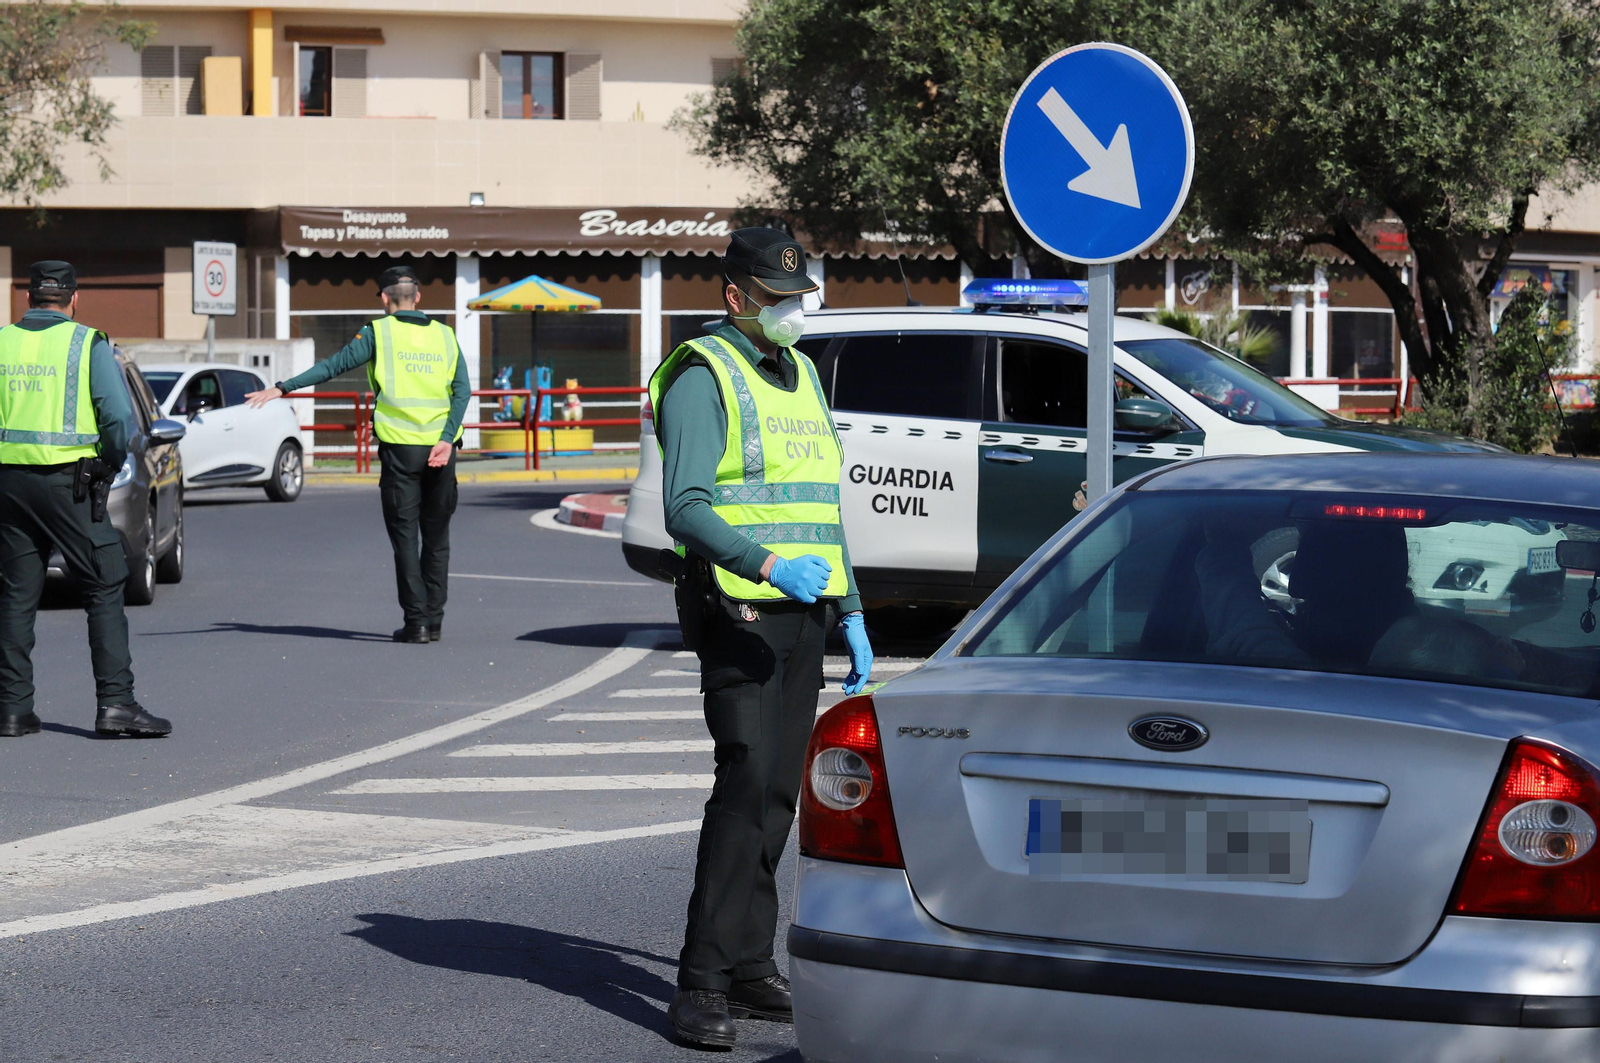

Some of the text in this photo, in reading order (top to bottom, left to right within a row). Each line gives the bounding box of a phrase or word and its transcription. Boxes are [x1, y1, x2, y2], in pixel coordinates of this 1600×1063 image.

[343, 210, 407, 225] Desayunos
[579, 209, 732, 236] Brasería
[300, 225, 449, 241] Tapas y Platos elaborados
[208, 271, 223, 286] 30
[397, 351, 443, 362] GUARDIA
[0, 364, 57, 377] GUARDIA
[405, 363, 434, 374] CIVIL
[9, 379, 43, 392] CIVIL
[766, 416, 831, 437] GUARDIA
[786, 440, 824, 460] CIVIL
[849, 464, 954, 491] GUARDIA
[871, 494, 929, 517] CIVIL
[898, 725, 970, 739] FOCUS
[1146, 721, 1187, 742] Ford
